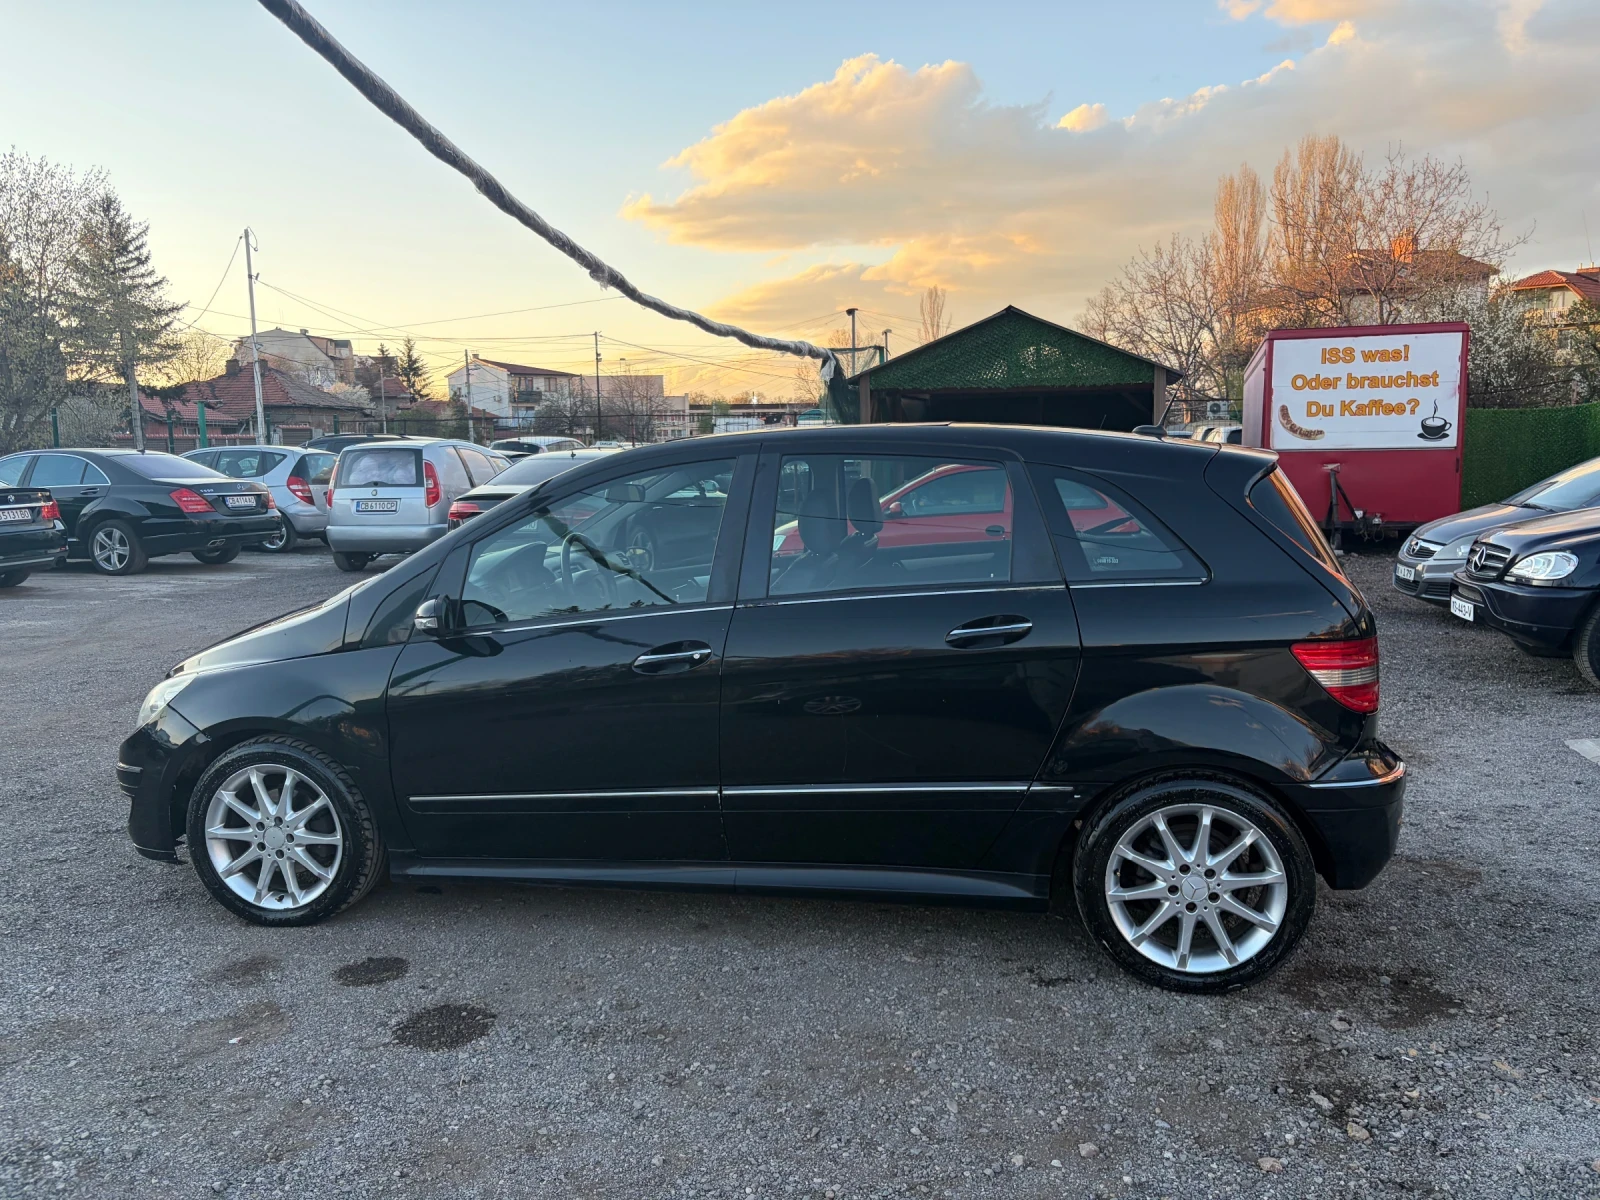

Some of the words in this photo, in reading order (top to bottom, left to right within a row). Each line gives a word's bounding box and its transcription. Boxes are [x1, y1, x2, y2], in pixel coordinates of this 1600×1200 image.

[1320, 346, 1356, 364] ISS
[1360, 344, 1410, 363] was!
[1291, 373, 1342, 391] Oder
[1346, 370, 1439, 389] brauchst
[1306, 400, 1335, 417] Du
[1340, 398, 1420, 417] Kaffee?
